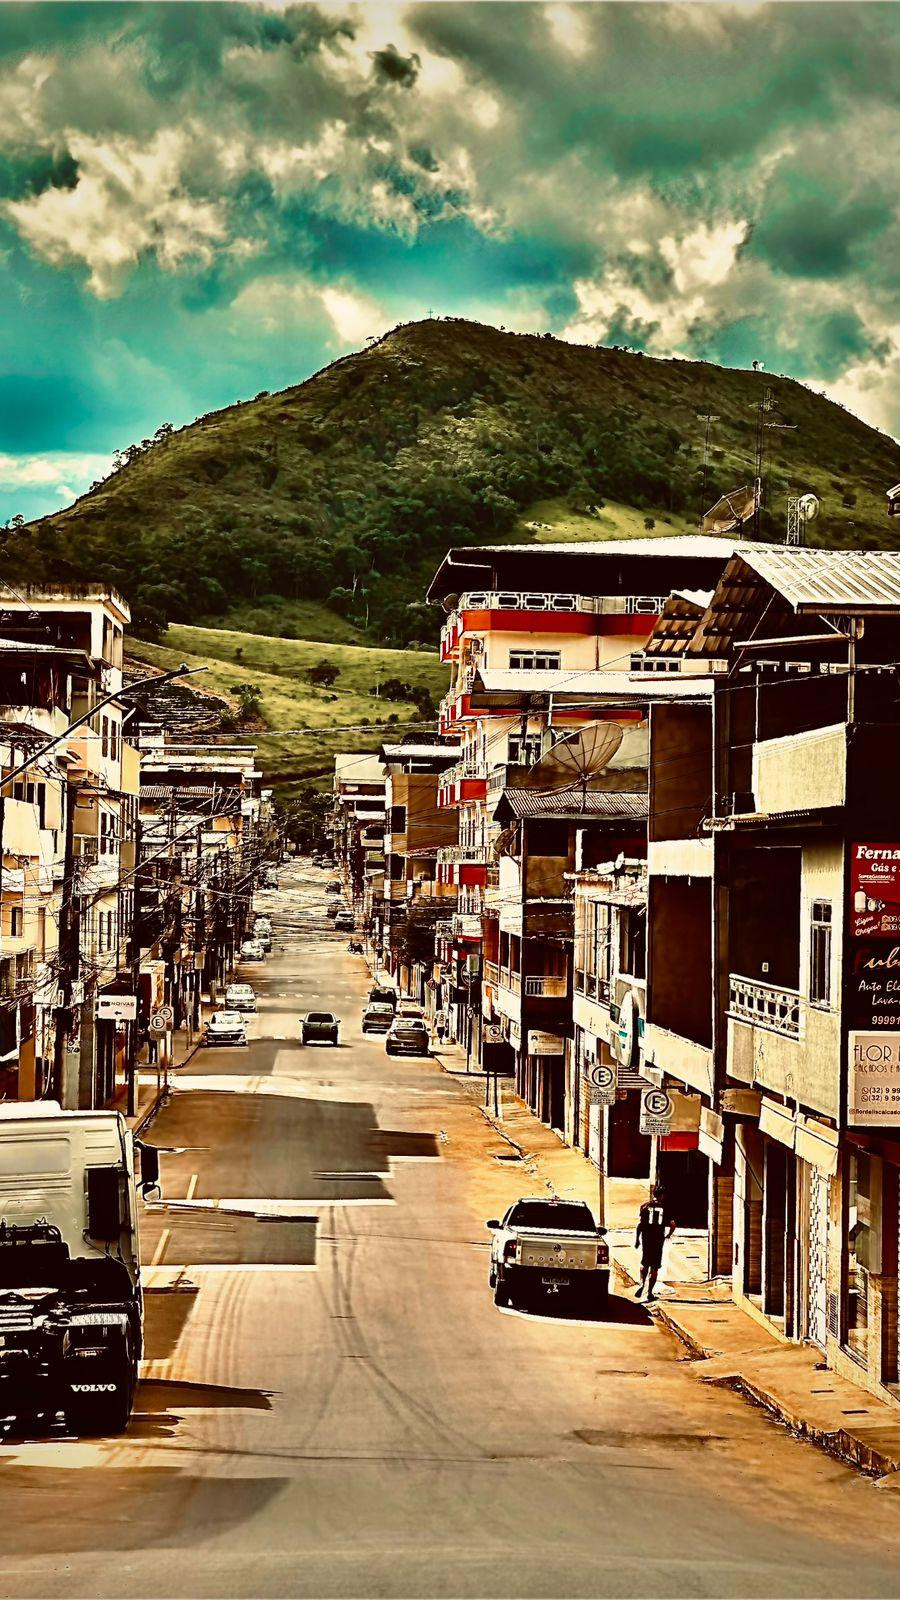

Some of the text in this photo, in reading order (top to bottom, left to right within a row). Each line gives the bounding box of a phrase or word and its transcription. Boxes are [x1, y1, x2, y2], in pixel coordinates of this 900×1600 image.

[871, 862, 889, 872] Gás
[858, 980, 882, 991] Auto
[155, 1018, 161, 1026] E
[853, 1044, 892, 1062] FLOR
[598, 1070, 606, 1083] E
[869, 1087, 883, 1095] (32)
[652, 1095, 662, 1109] E
[648, 1207, 664, 1225] 17
[71, 1384, 117, 1392] VOLVO
